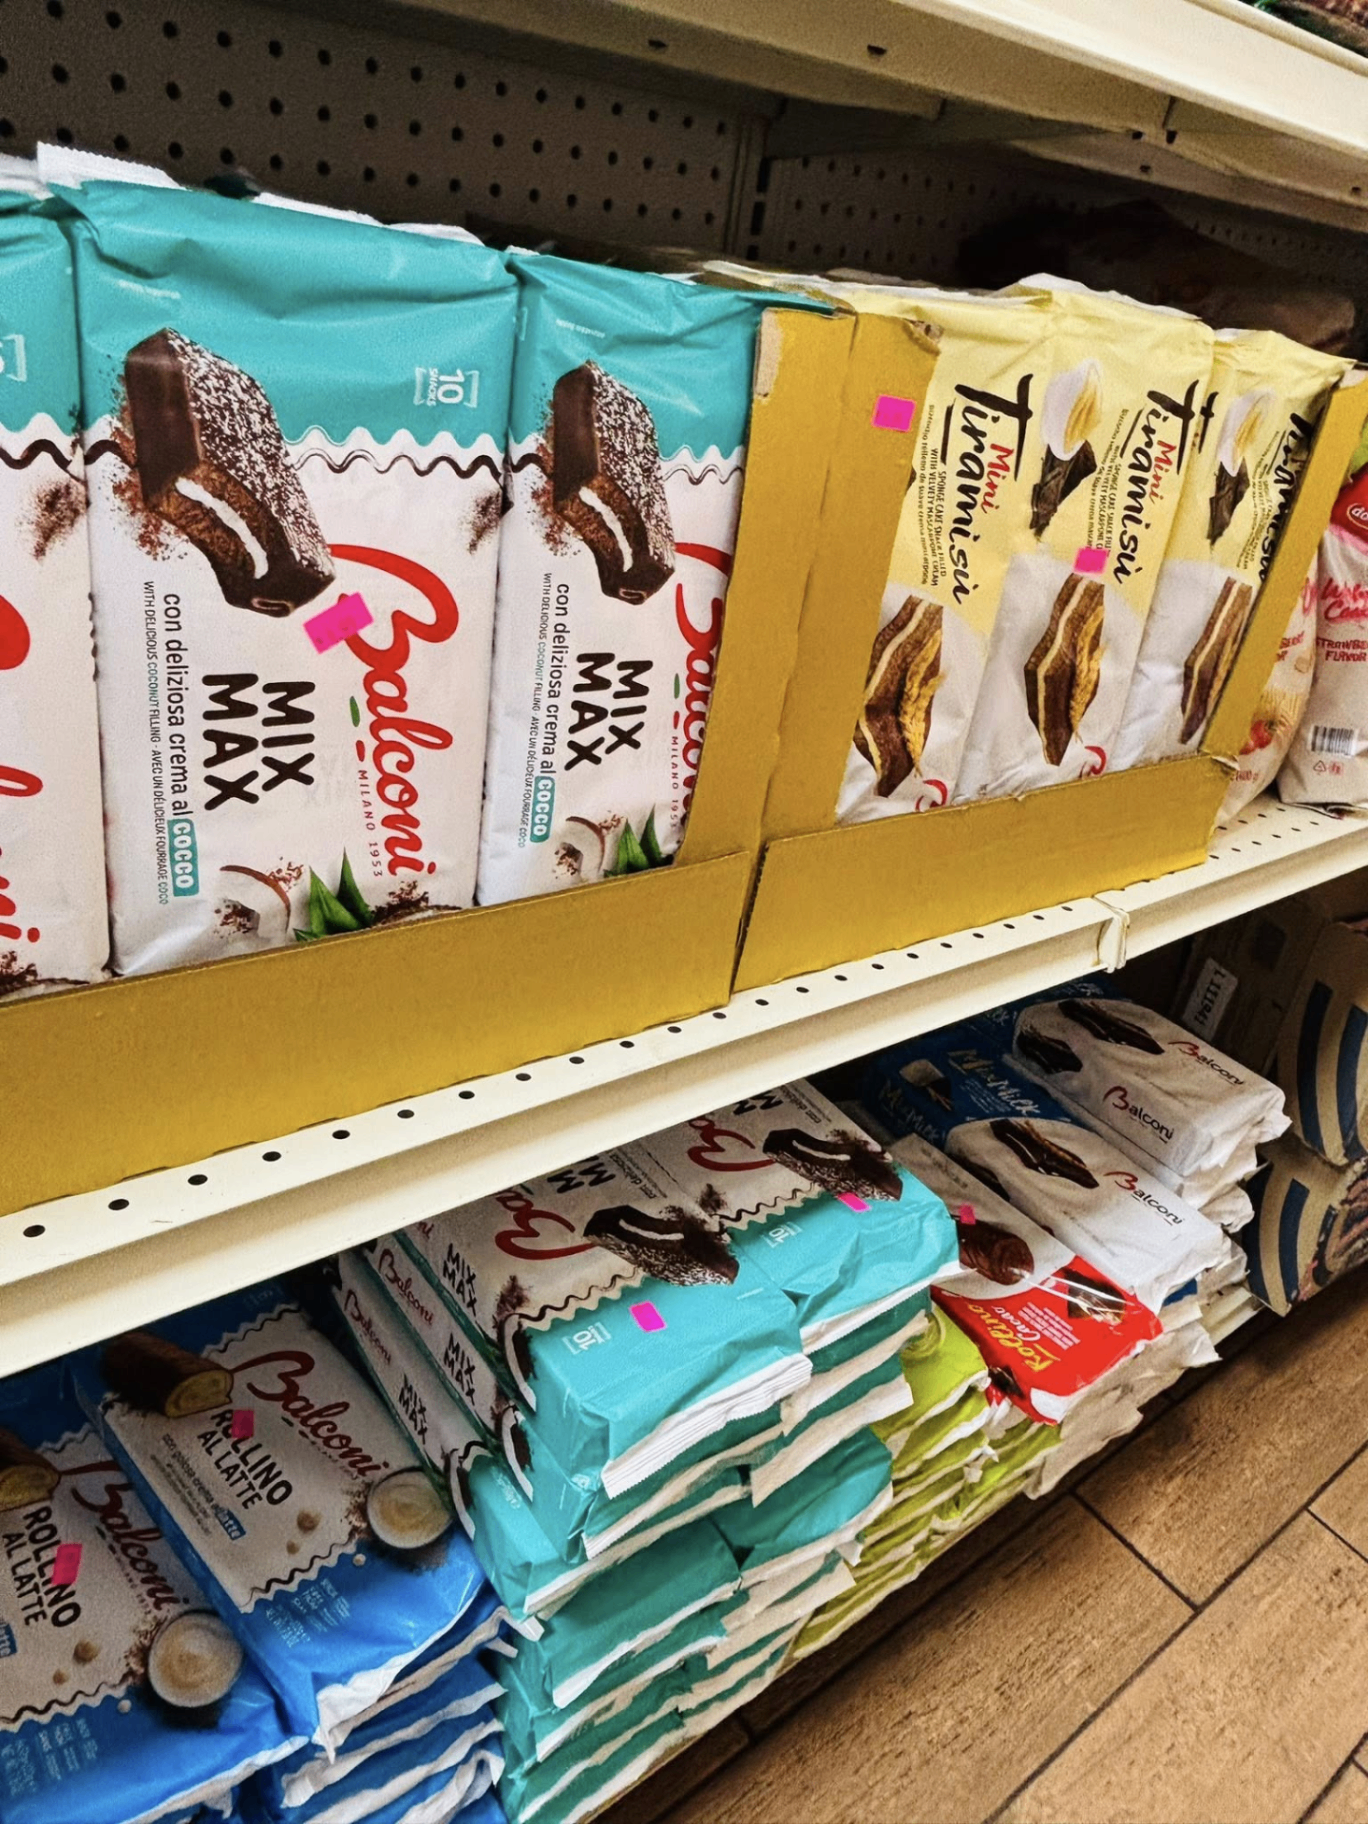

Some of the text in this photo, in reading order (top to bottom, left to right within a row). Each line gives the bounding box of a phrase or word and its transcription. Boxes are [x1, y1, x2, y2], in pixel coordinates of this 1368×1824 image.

[438, 368, 464, 404] 10
[980, 443, 1014, 514] Mini
[1150, 440, 1177, 504] Mini
[143, 581, 154, 607] WITH
[542, 572, 552, 593] WITH
[144, 609, 158, 660] DELICIOUS
[147, 662, 160, 708] COCONUT
[326, 543, 459, 876] Balconi
[533, 583, 570, 837] con deliziosa crema al COCCO
[564, 652, 616, 771] MAX
[604, 660, 654, 754] MIX
[152, 750, 162, 774] AVEC
[163, 593, 194, 888] con deliziosa crema al COCCO
[201, 673, 260, 811] MAX
[261, 681, 316, 792] MIX
[153, 775, 164, 790] UN
[358, 770, 382, 876] MILANO 1953
[1168, 1041, 1244, 1086] Balconi
[1102, 1086, 1174, 1140] Balconi
[1103, 1171, 1185, 1225] Balconi
[378, 1248, 434, 1326] Balconi
[443, 1260, 477, 1317] MAX
[446, 1243, 476, 1294] MIX
[344, 1288, 392, 1366] Balconi
[572, 1330, 596, 1350] 10
[967, 1303, 1053, 1372] Rollino
[991, 1306, 1040, 1342] Cacao
[444, 1347, 476, 1406] MAX
[449, 1333, 476, 1385] MIX
[230, 1350, 390, 1476] Balconi
[399, 1385, 428, 1445] MAX
[403, 1373, 427, 1424] MIX
[196, 1430, 263, 1510] AL LATTE
[61, 1460, 190, 1610] Balconi
[2, 1532, 48, 1626] AL LATTE
